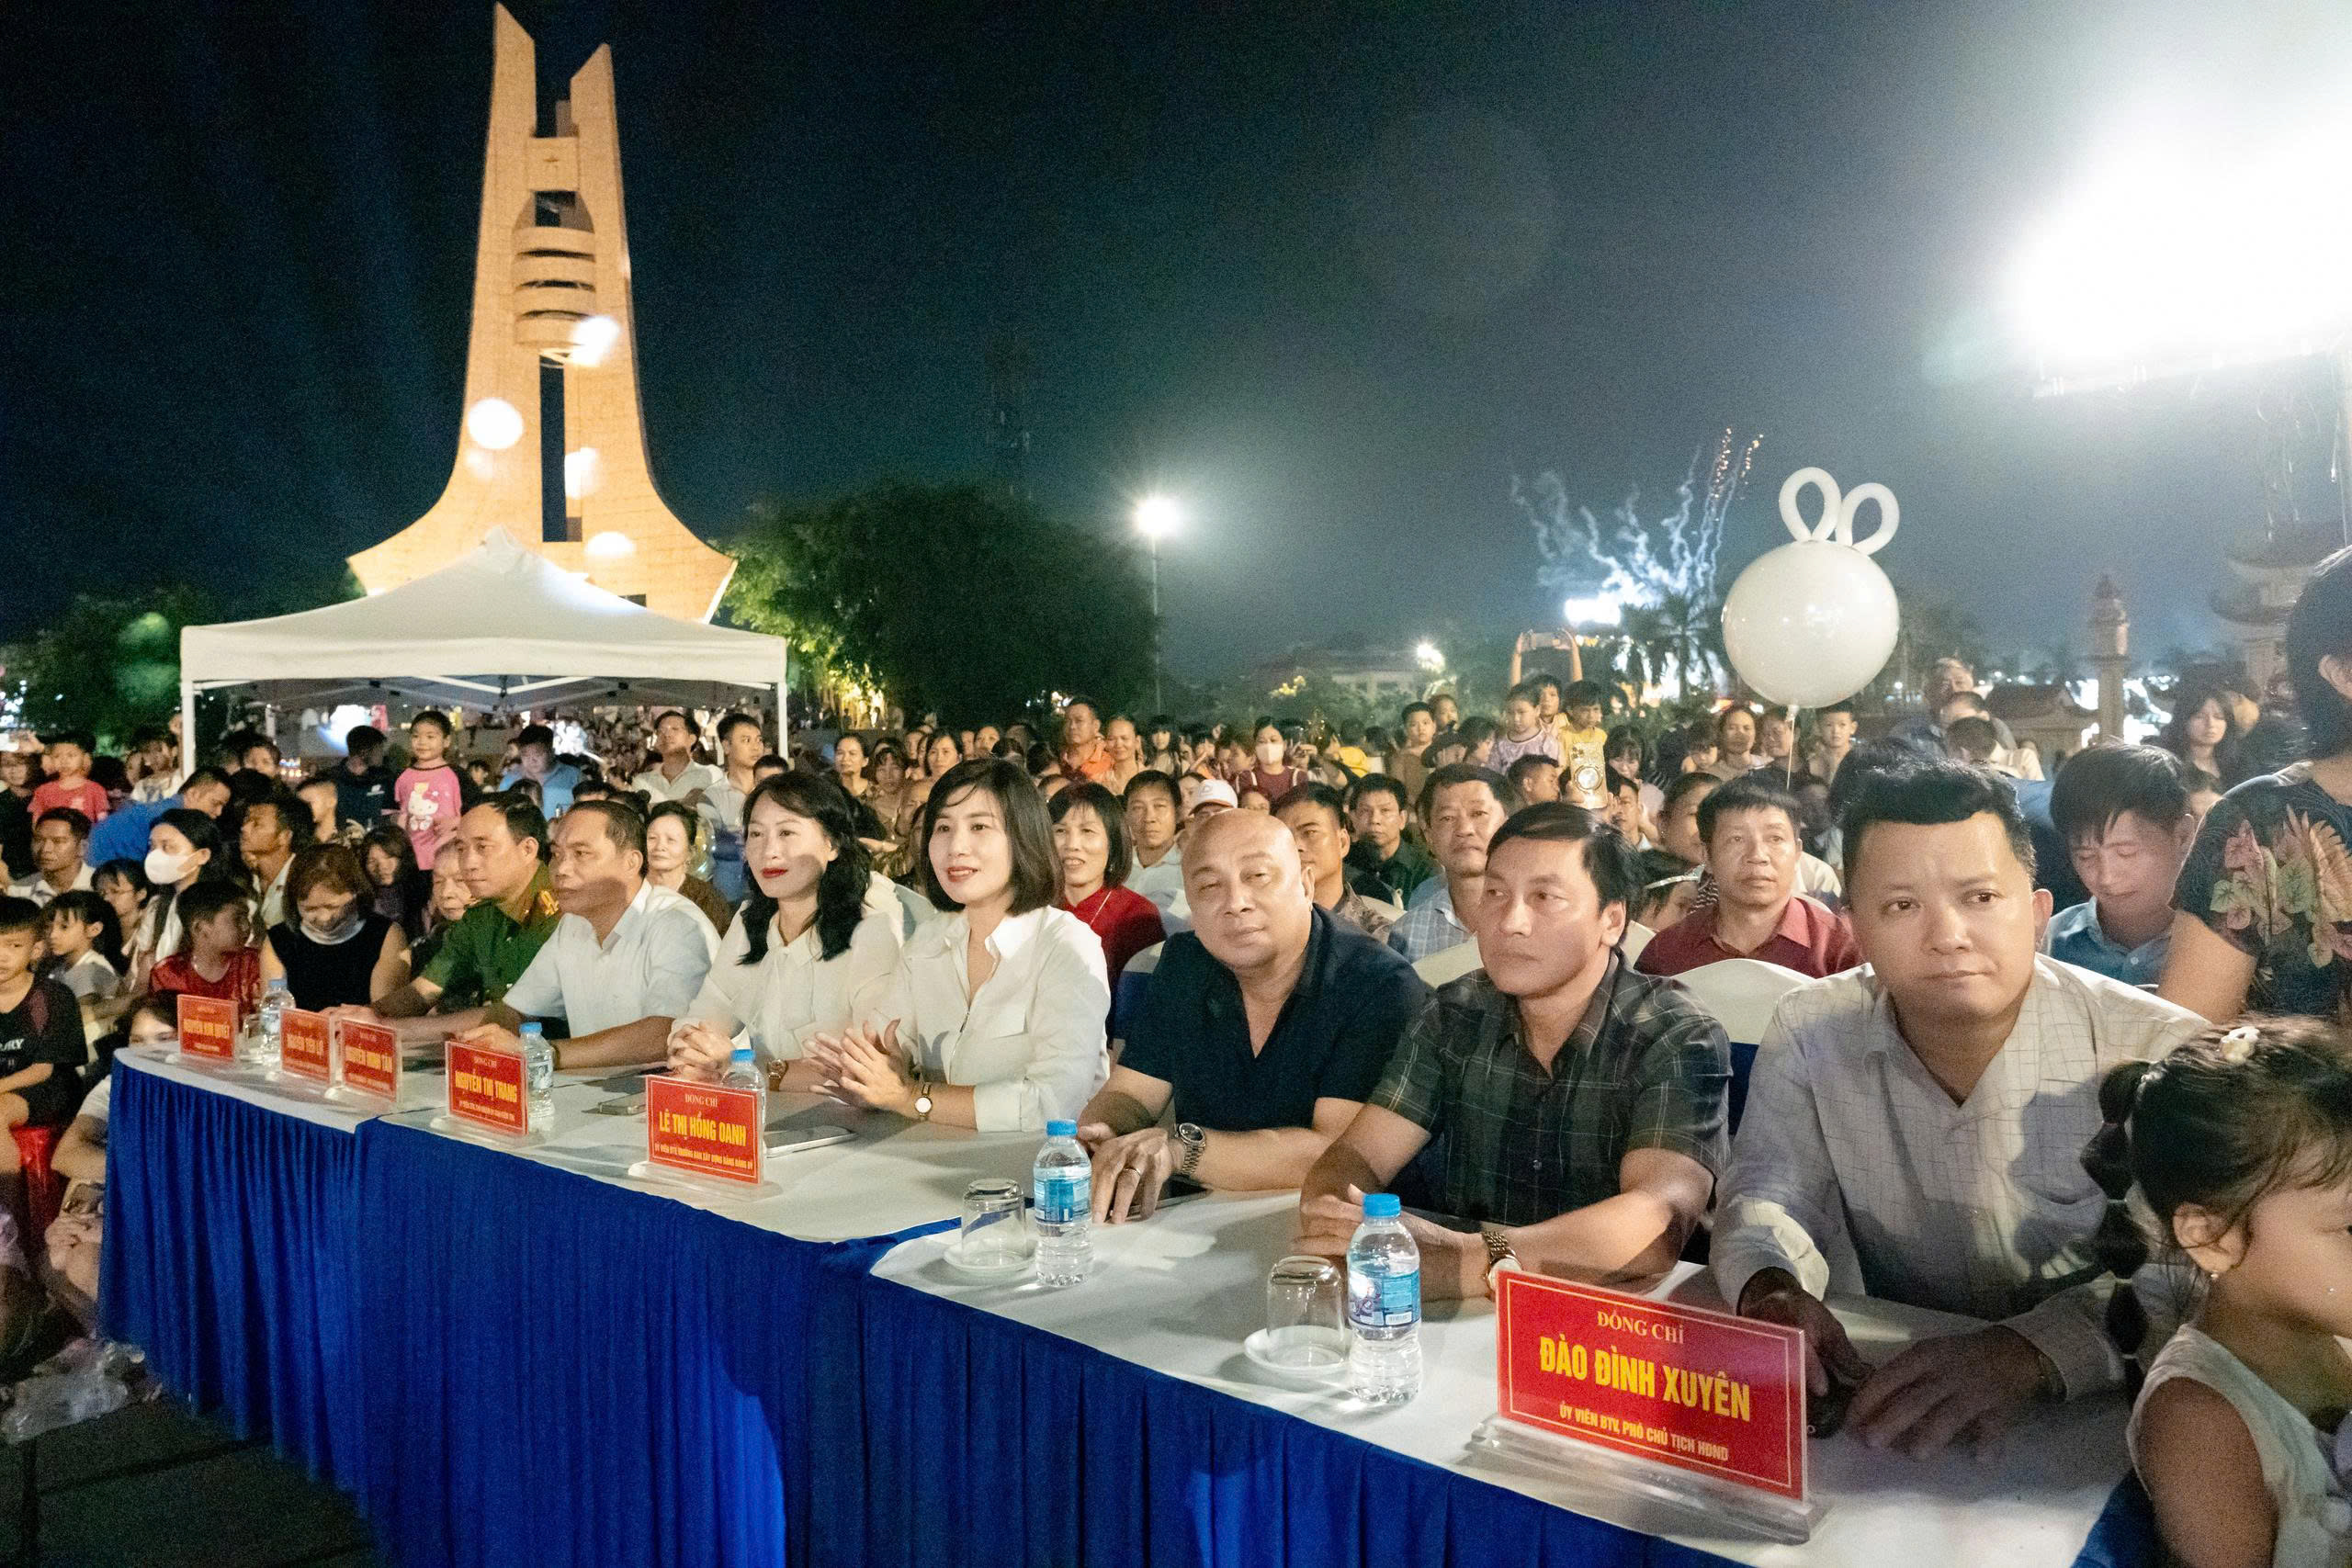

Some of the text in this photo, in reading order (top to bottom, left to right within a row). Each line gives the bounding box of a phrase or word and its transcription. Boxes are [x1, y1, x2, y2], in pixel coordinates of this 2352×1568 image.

[659, 1109, 671, 1133] LÊ
[672, 1113, 688, 1140] THỊ
[718, 1122, 747, 1147] OANH
[1652, 1324, 1684, 1345] CHÍ
[1539, 1334, 1750, 1422] ĐÀO ĐÌNH XUYÊN
[1575, 1407, 1599, 1427] VIÊN
[1645, 1427, 1668, 1446] CHỦ
